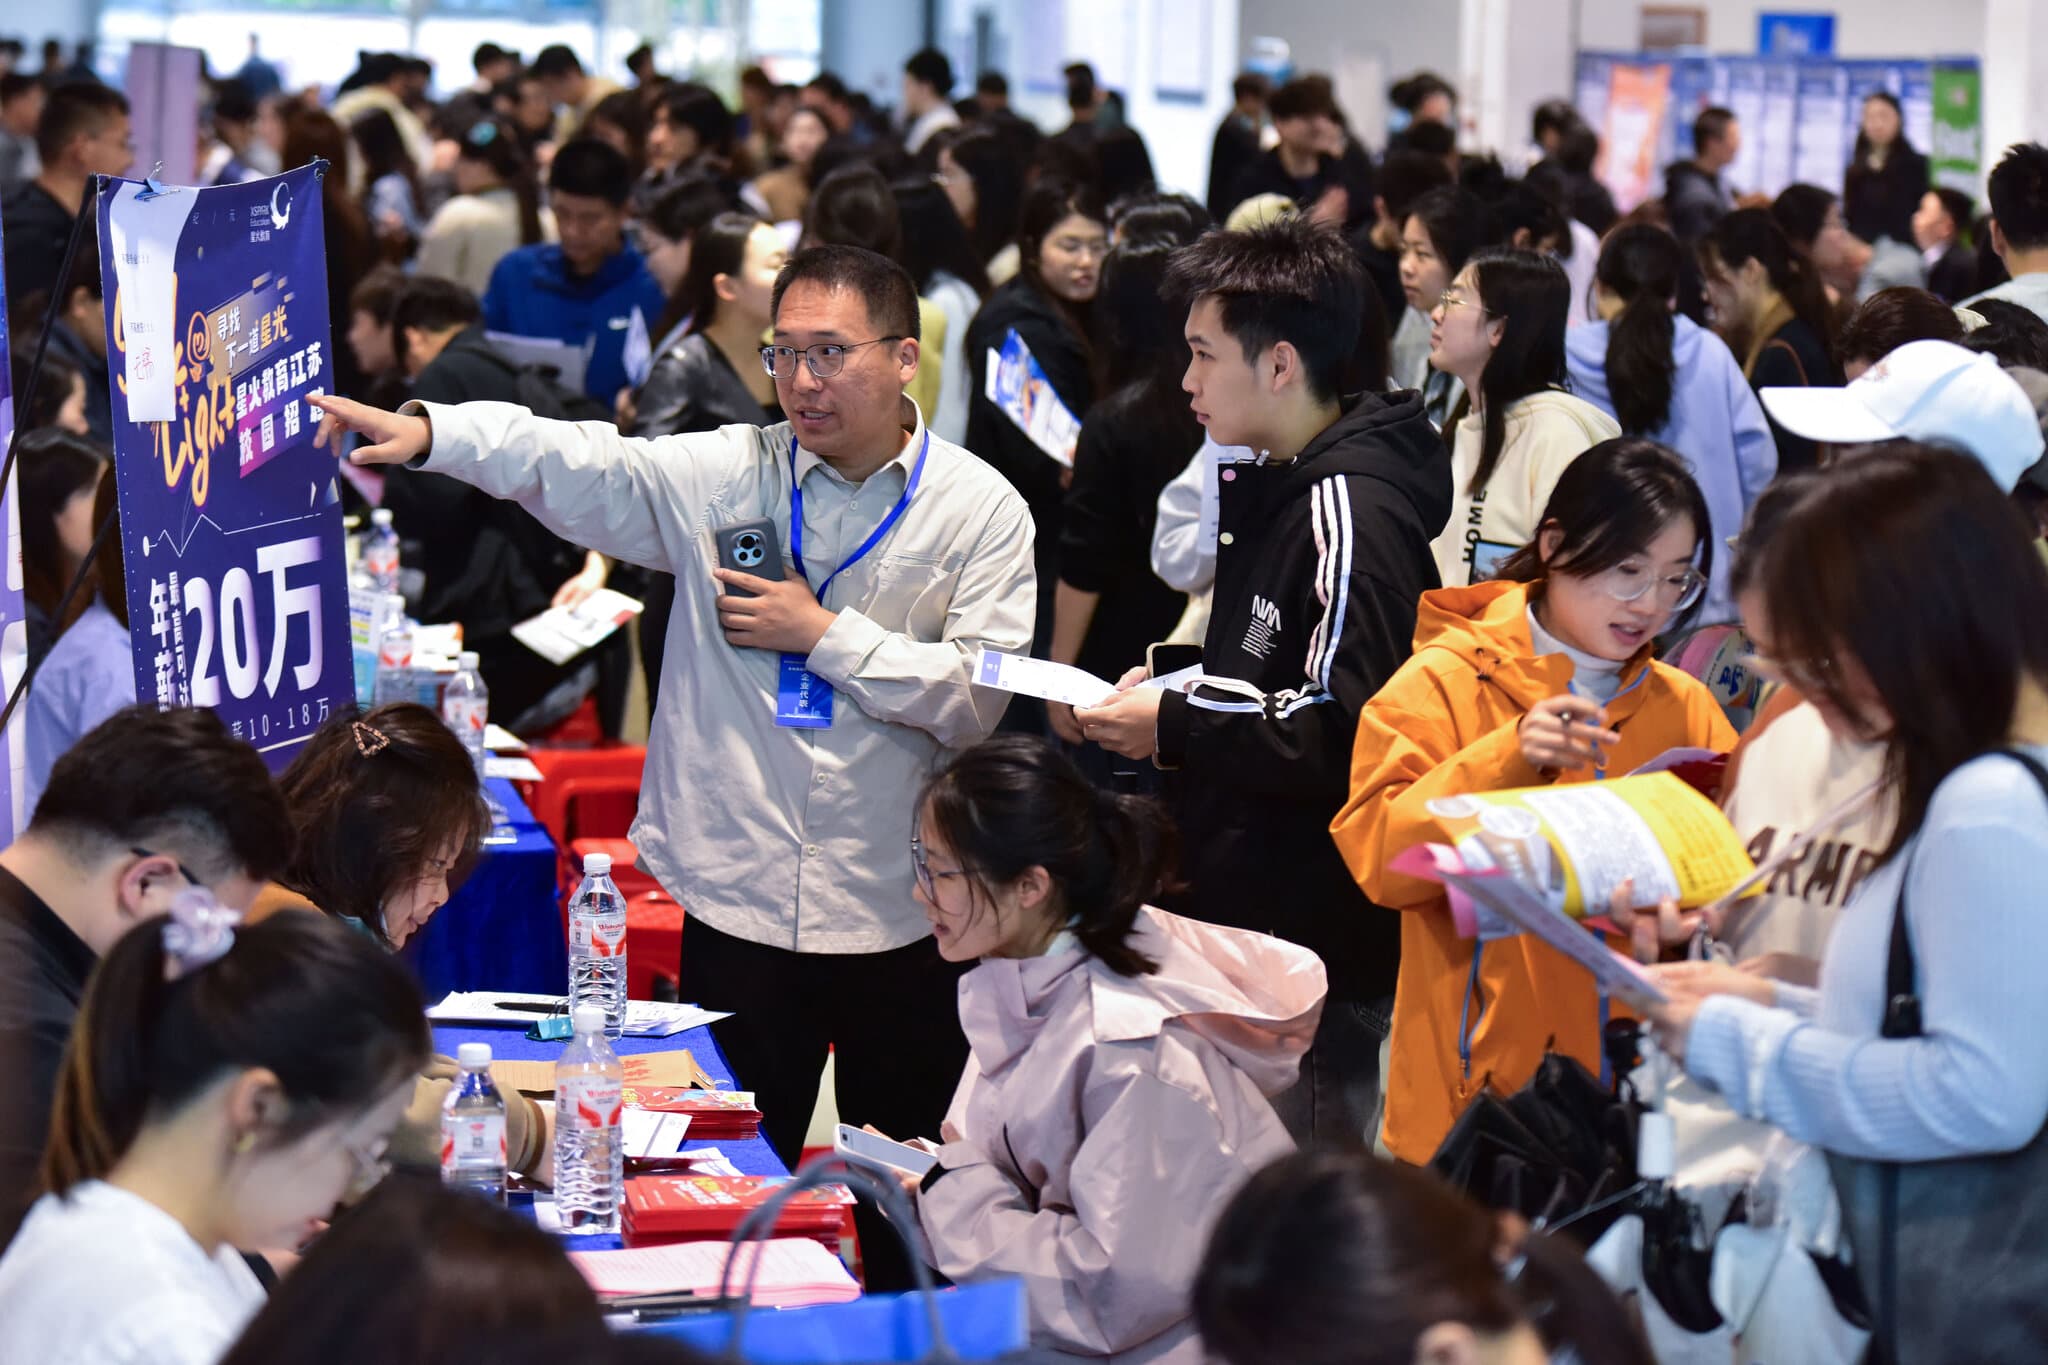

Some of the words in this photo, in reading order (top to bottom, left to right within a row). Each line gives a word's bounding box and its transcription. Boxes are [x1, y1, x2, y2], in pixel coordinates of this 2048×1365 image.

[217, 306, 241, 342] 寻找
[225, 304, 289, 369] 下一道星光
[236, 341, 323, 421] 星火教育江苏
[184, 536, 324, 708] 20万
